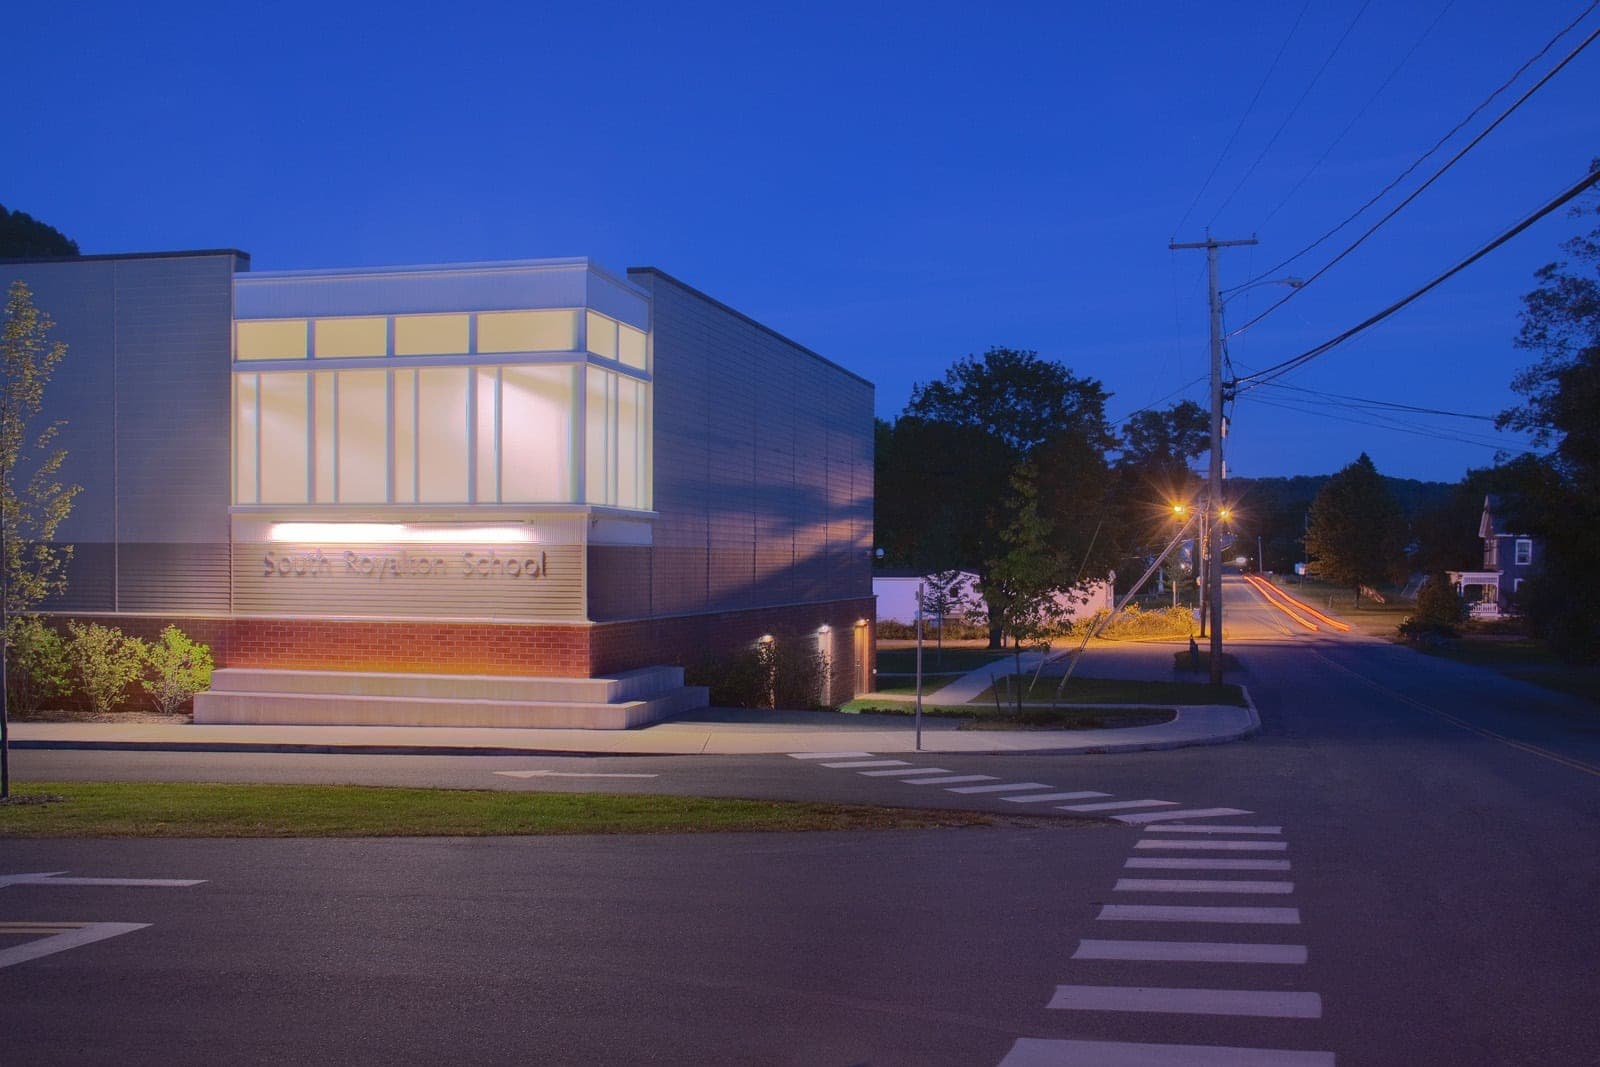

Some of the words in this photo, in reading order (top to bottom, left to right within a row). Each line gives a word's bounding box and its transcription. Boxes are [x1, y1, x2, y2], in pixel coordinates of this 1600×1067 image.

[264, 550, 332, 578] South
[345, 550, 446, 580] Royalton
[462, 550, 547, 577] School
